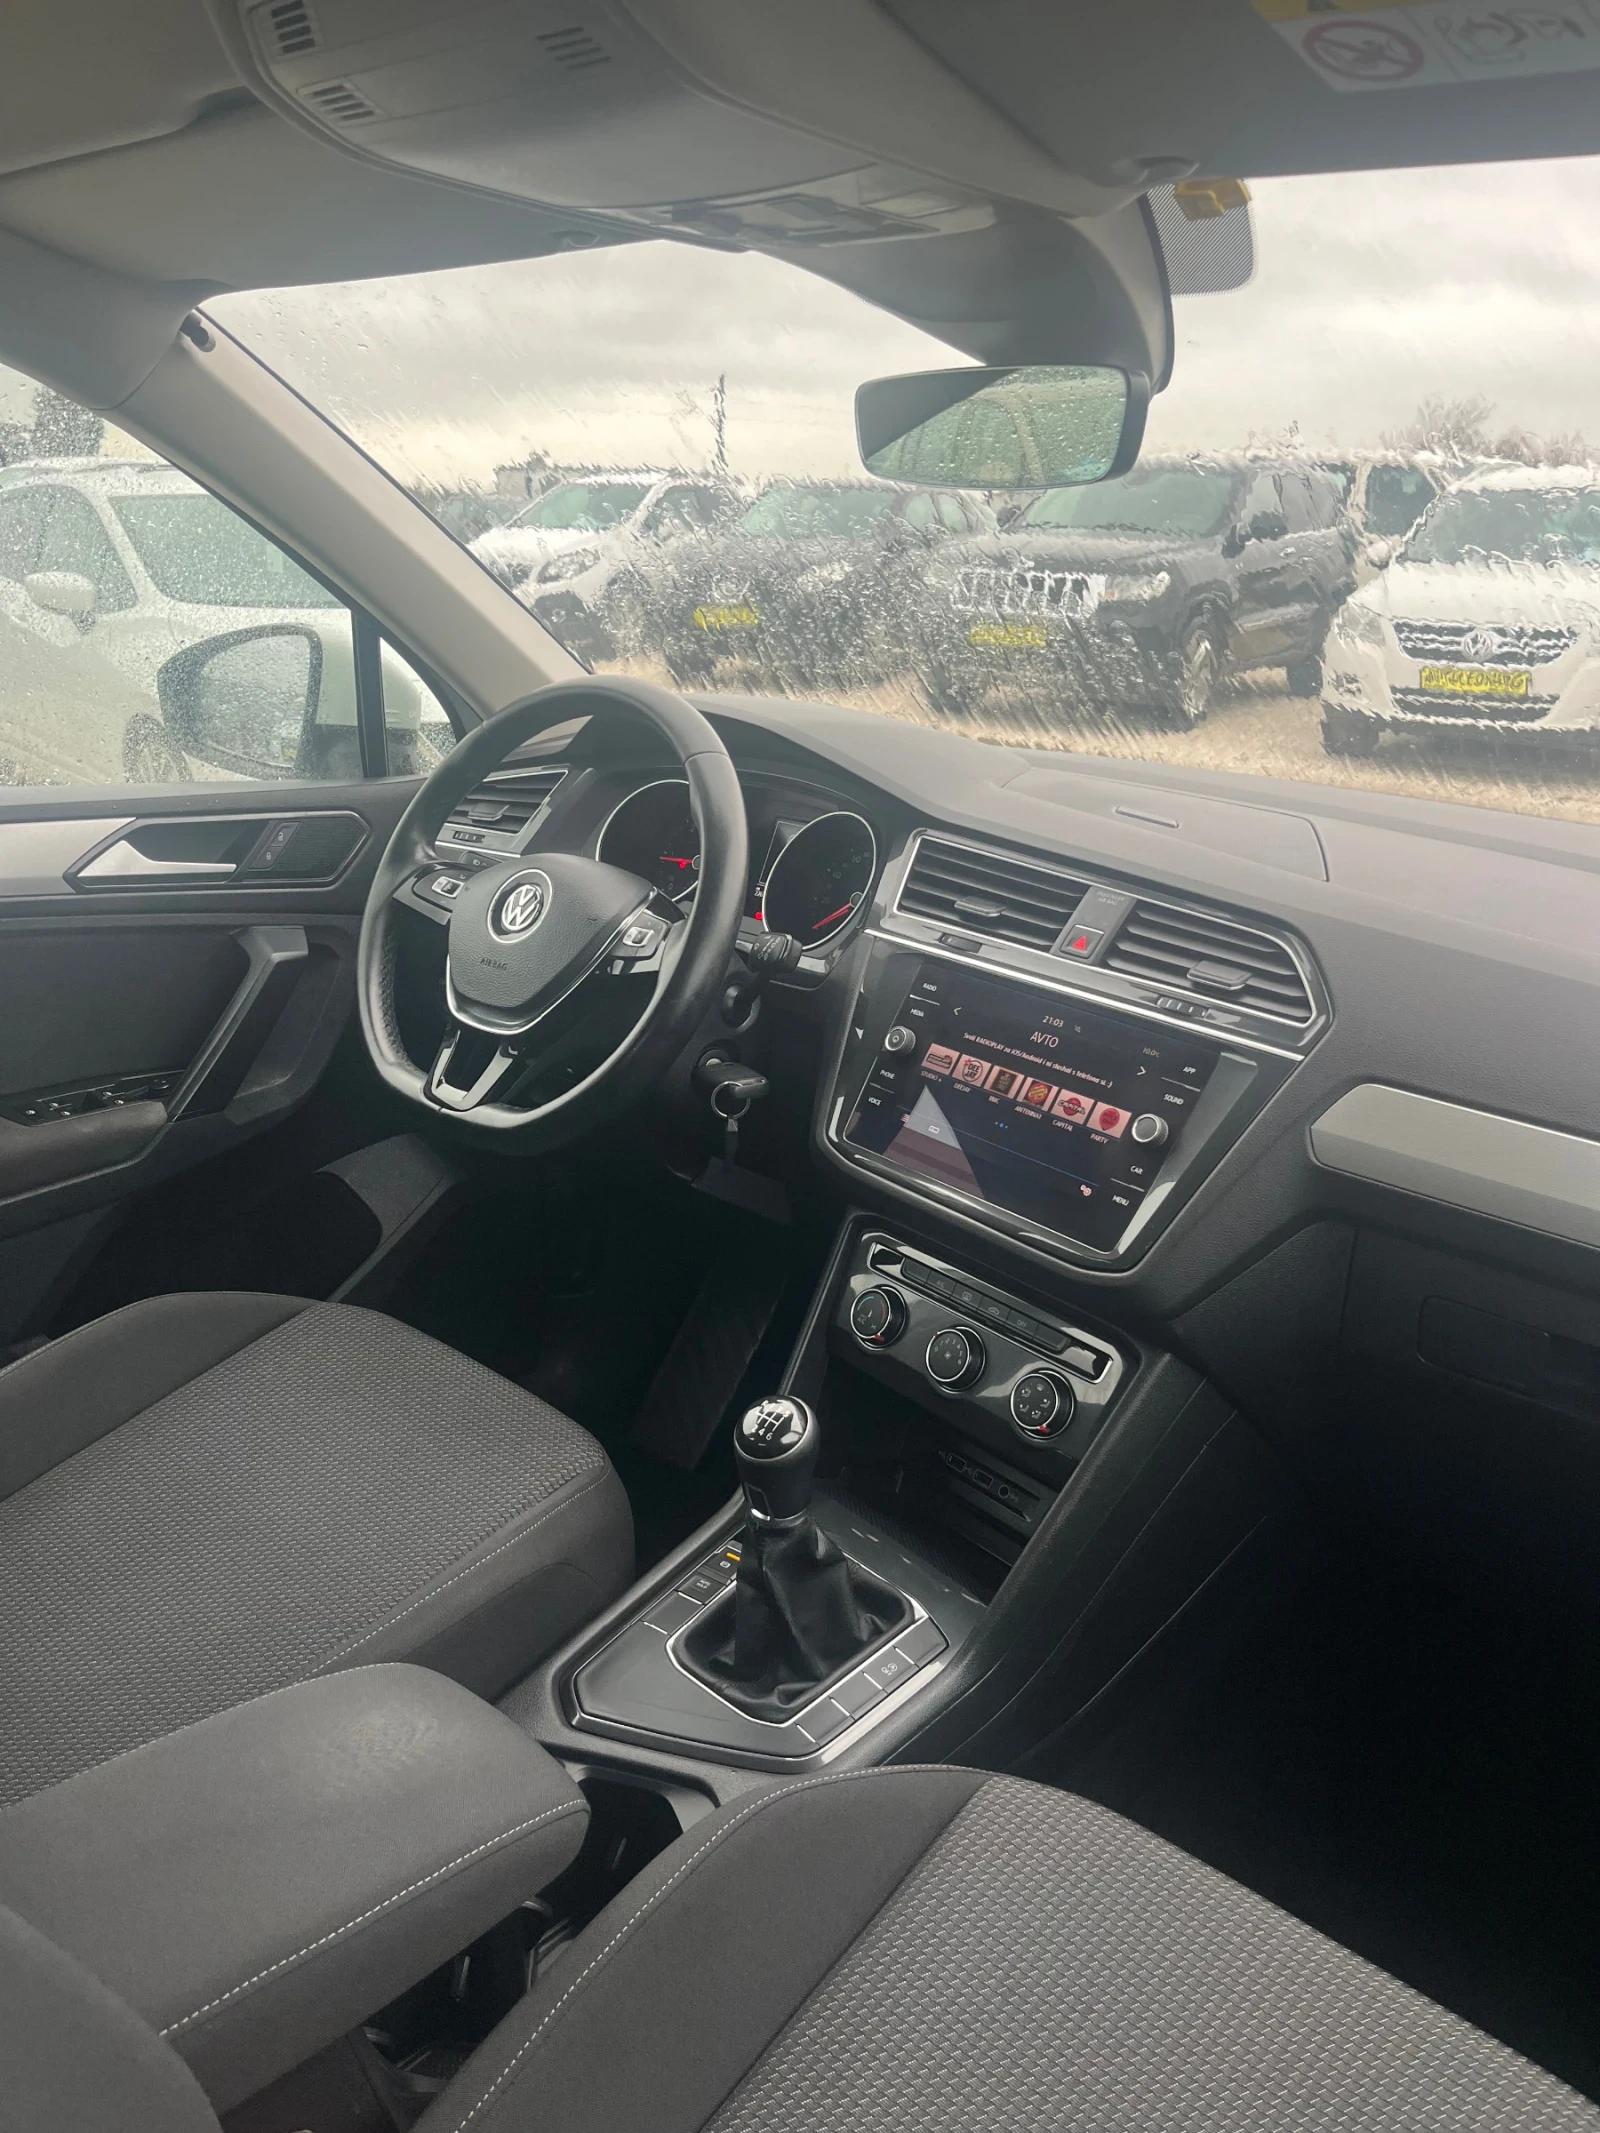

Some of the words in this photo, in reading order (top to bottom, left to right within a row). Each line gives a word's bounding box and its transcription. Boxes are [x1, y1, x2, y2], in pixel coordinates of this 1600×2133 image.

[922, 982, 938, 992] RADIO
[909, 1008, 925, 1018] MEDIA
[1042, 1015, 1064, 1028] 21:03
[1029, 1031, 1059, 1048] AVTO
[967, 1063, 981, 1073] DEE
[1182, 1066, 1196, 1074] APP
[880, 1069, 896, 1080] PHONE
[953, 1082, 972, 1093] DEEJAY
[868, 1096, 882, 1106] VOICE
[1163, 1093, 1184, 1105] SOUND
[1058, 1099, 1086, 1115] CAPITAL
[1052, 1119, 1075, 1132] CAPITAL
[1090, 1133, 1109, 1144] PARTY
[1130, 1165, 1143, 1175] CAR
[1112, 1195, 1130, 1206] MENU
[758, 1428, 766, 1436] 4
[766, 1432, 774, 1441] 6
